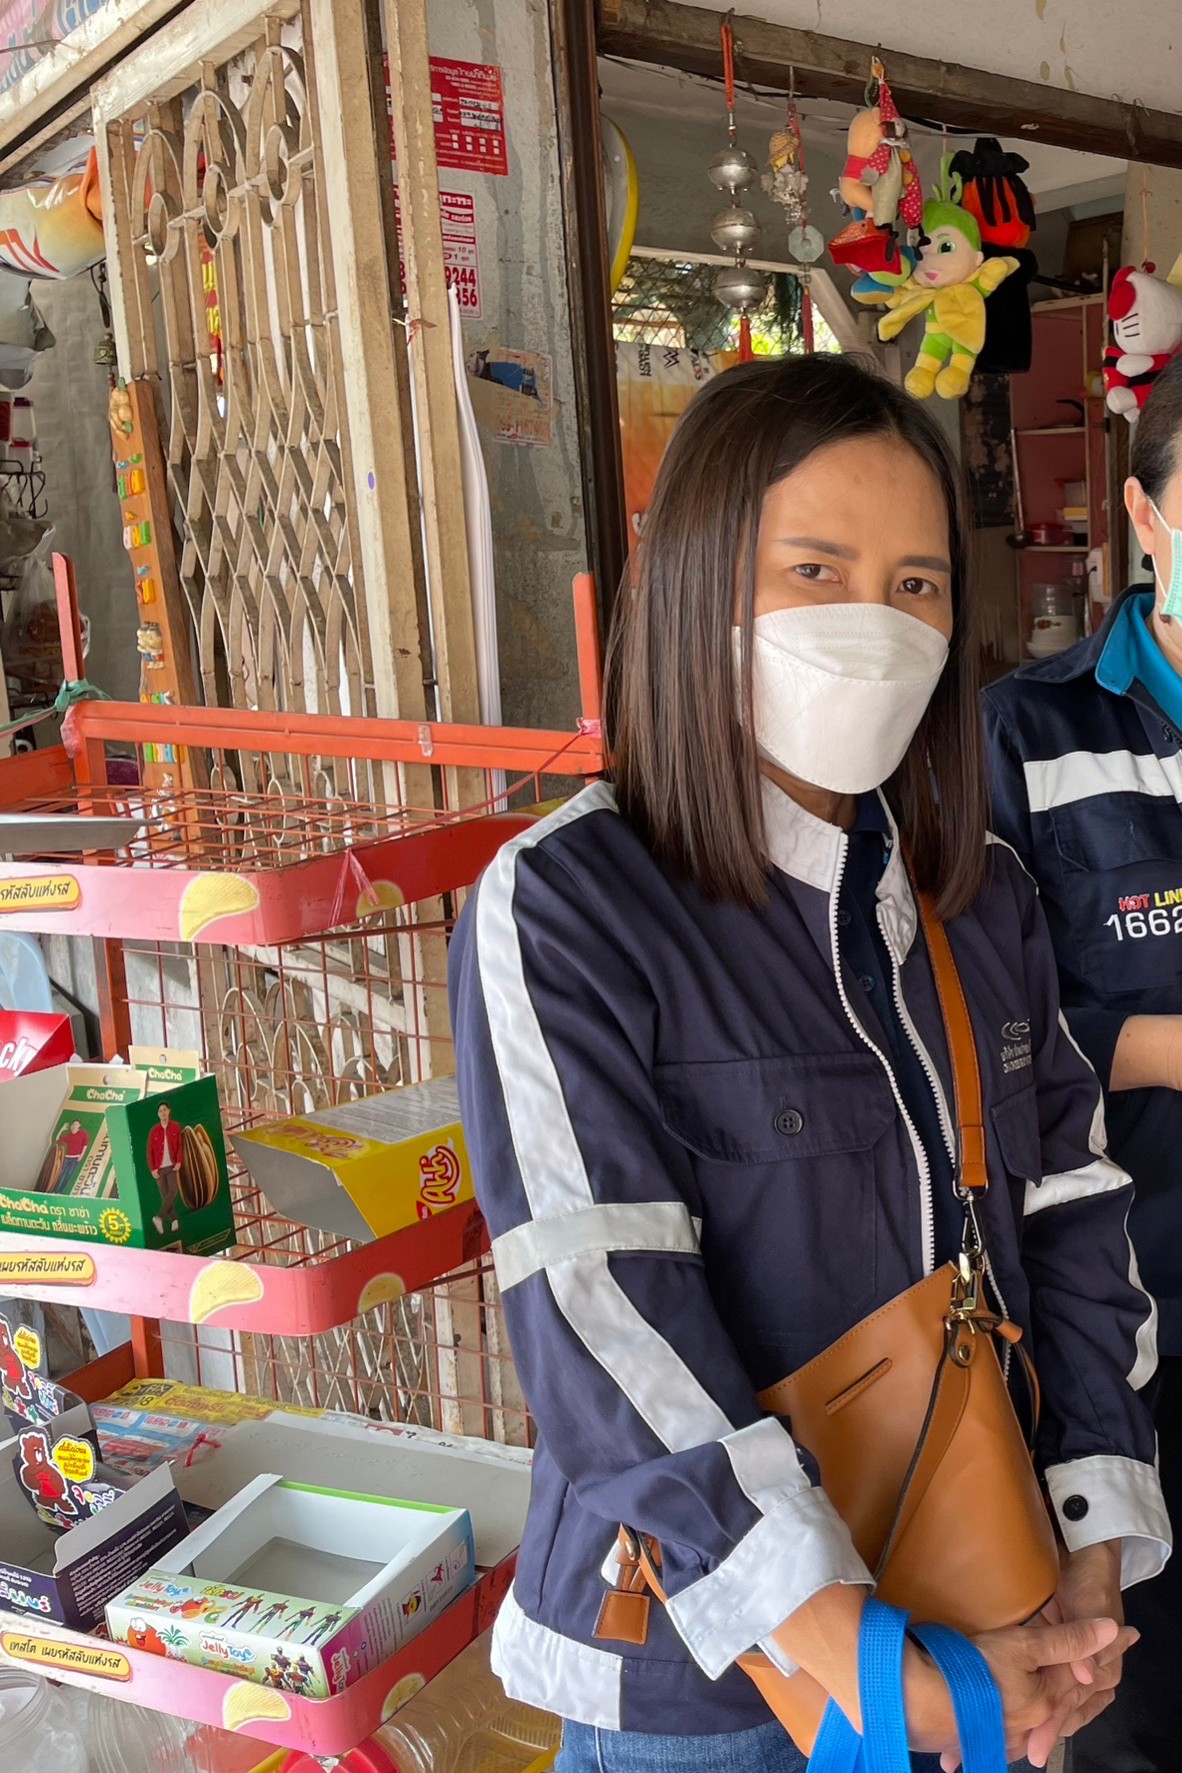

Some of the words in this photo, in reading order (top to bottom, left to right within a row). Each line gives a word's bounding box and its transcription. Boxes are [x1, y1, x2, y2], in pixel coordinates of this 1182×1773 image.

[1118, 893, 1150, 912] HOT
[148, 1067, 182, 1081] ChaCha
[86, 1088, 124, 1101] ChaCha
[0, 1192, 49, 1214] ChaCha
[50, 1204, 66, 1217] ตรา
[0, 1256, 87, 1273] ผยรหัสลับแห่งรส
